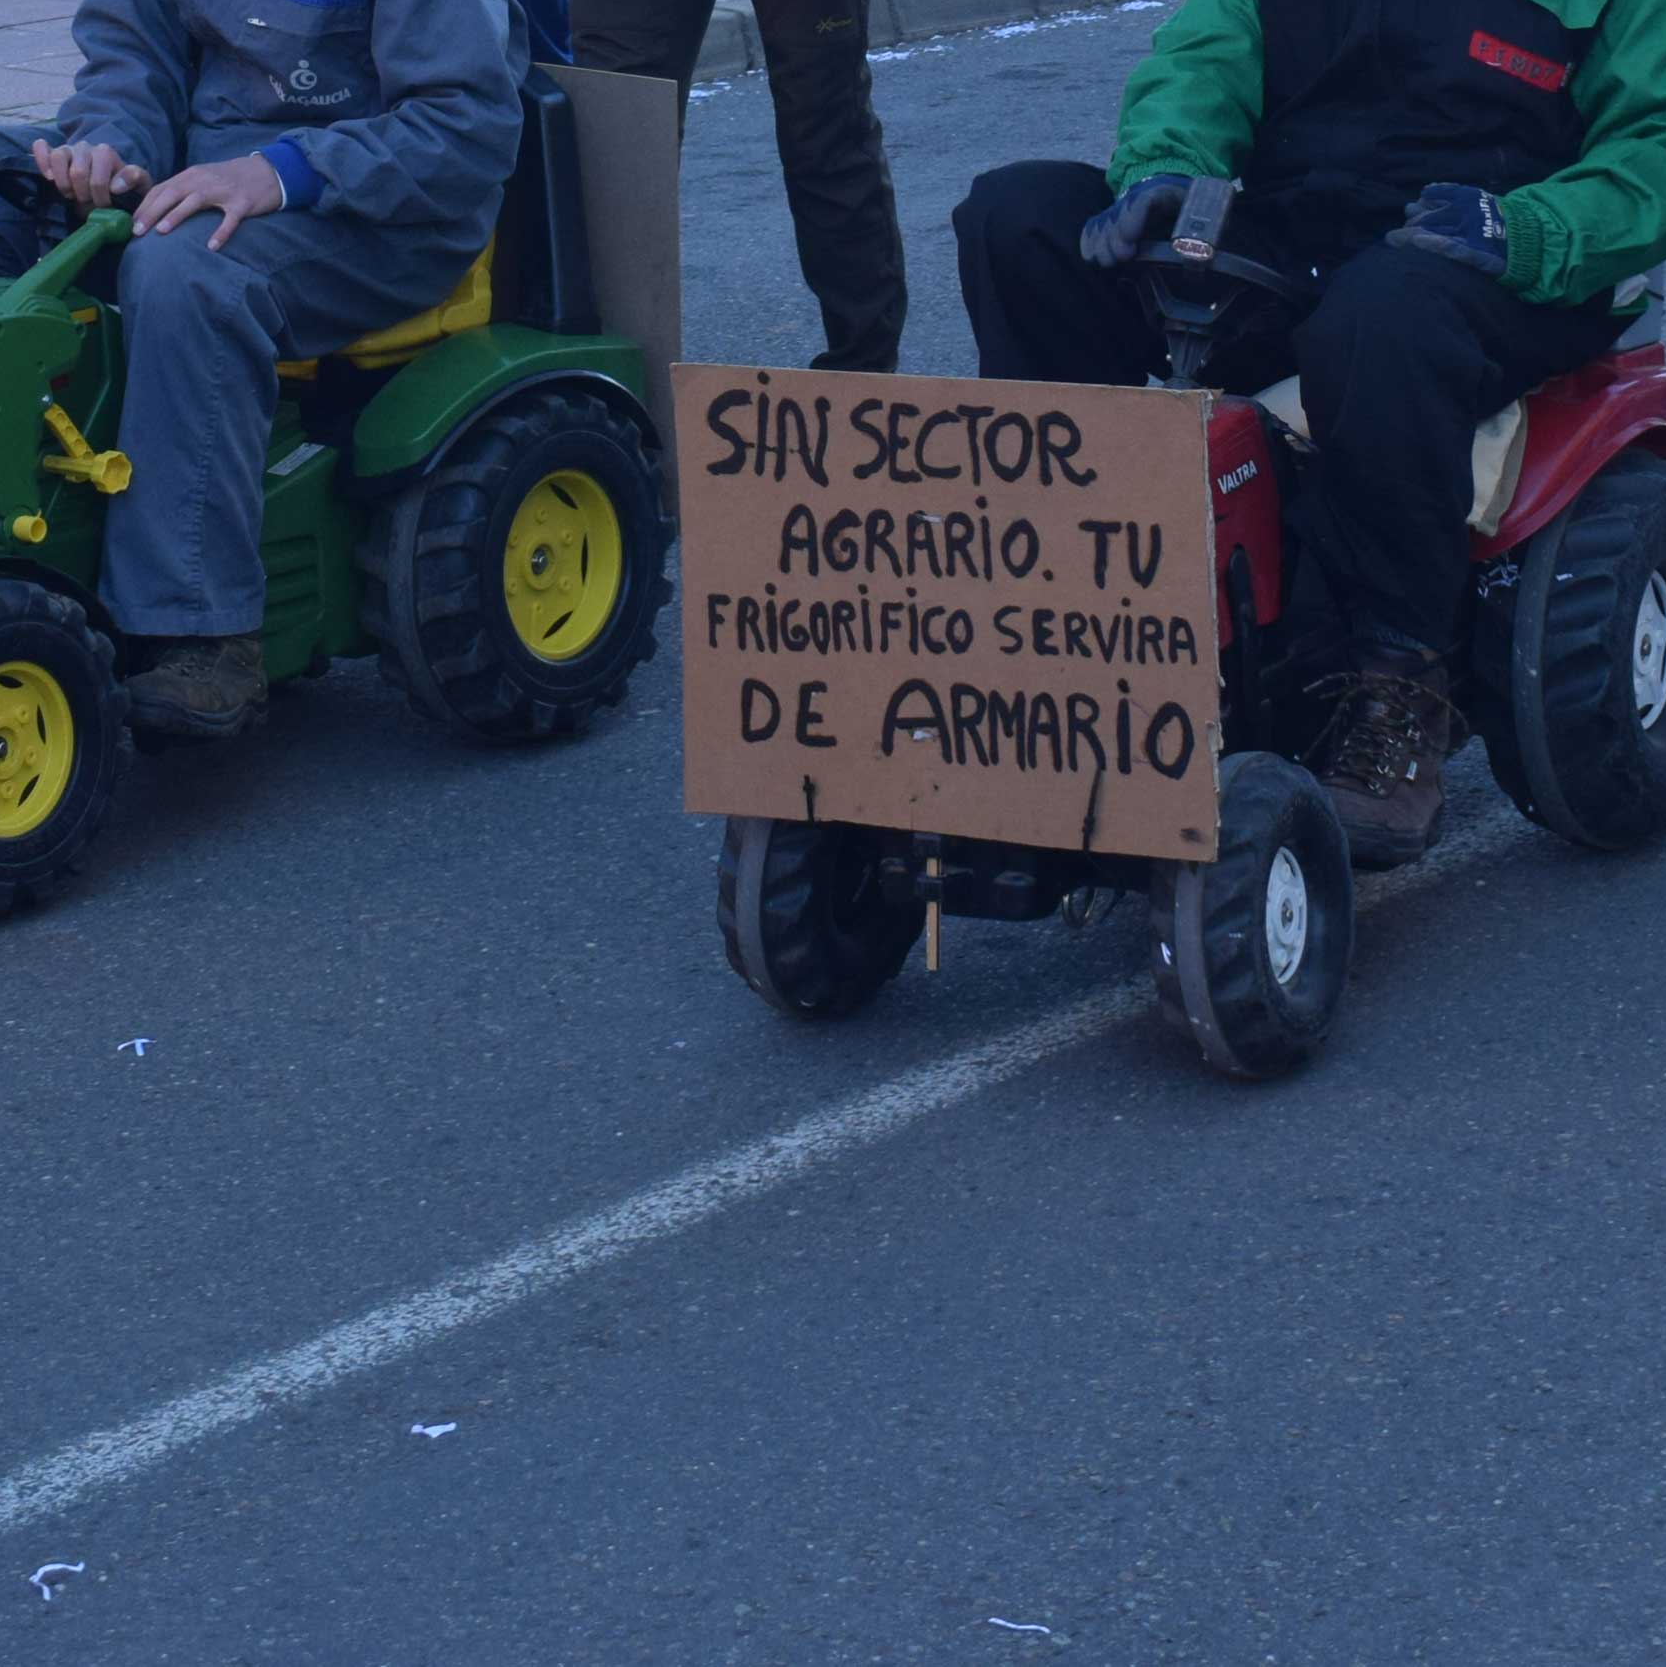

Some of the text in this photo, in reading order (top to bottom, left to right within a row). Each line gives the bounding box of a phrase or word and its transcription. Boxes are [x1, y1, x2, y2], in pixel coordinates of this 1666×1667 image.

[707, 371, 1098, 487] SIN SECTOR
[1217, 459, 1258, 495] VALTRA
[779, 496, 1163, 590] AGRARIO. TU
[707, 582, 1198, 665] FRIGORIFICO SERVIRA
[741, 677, 1196, 781] DE ARMARIO
